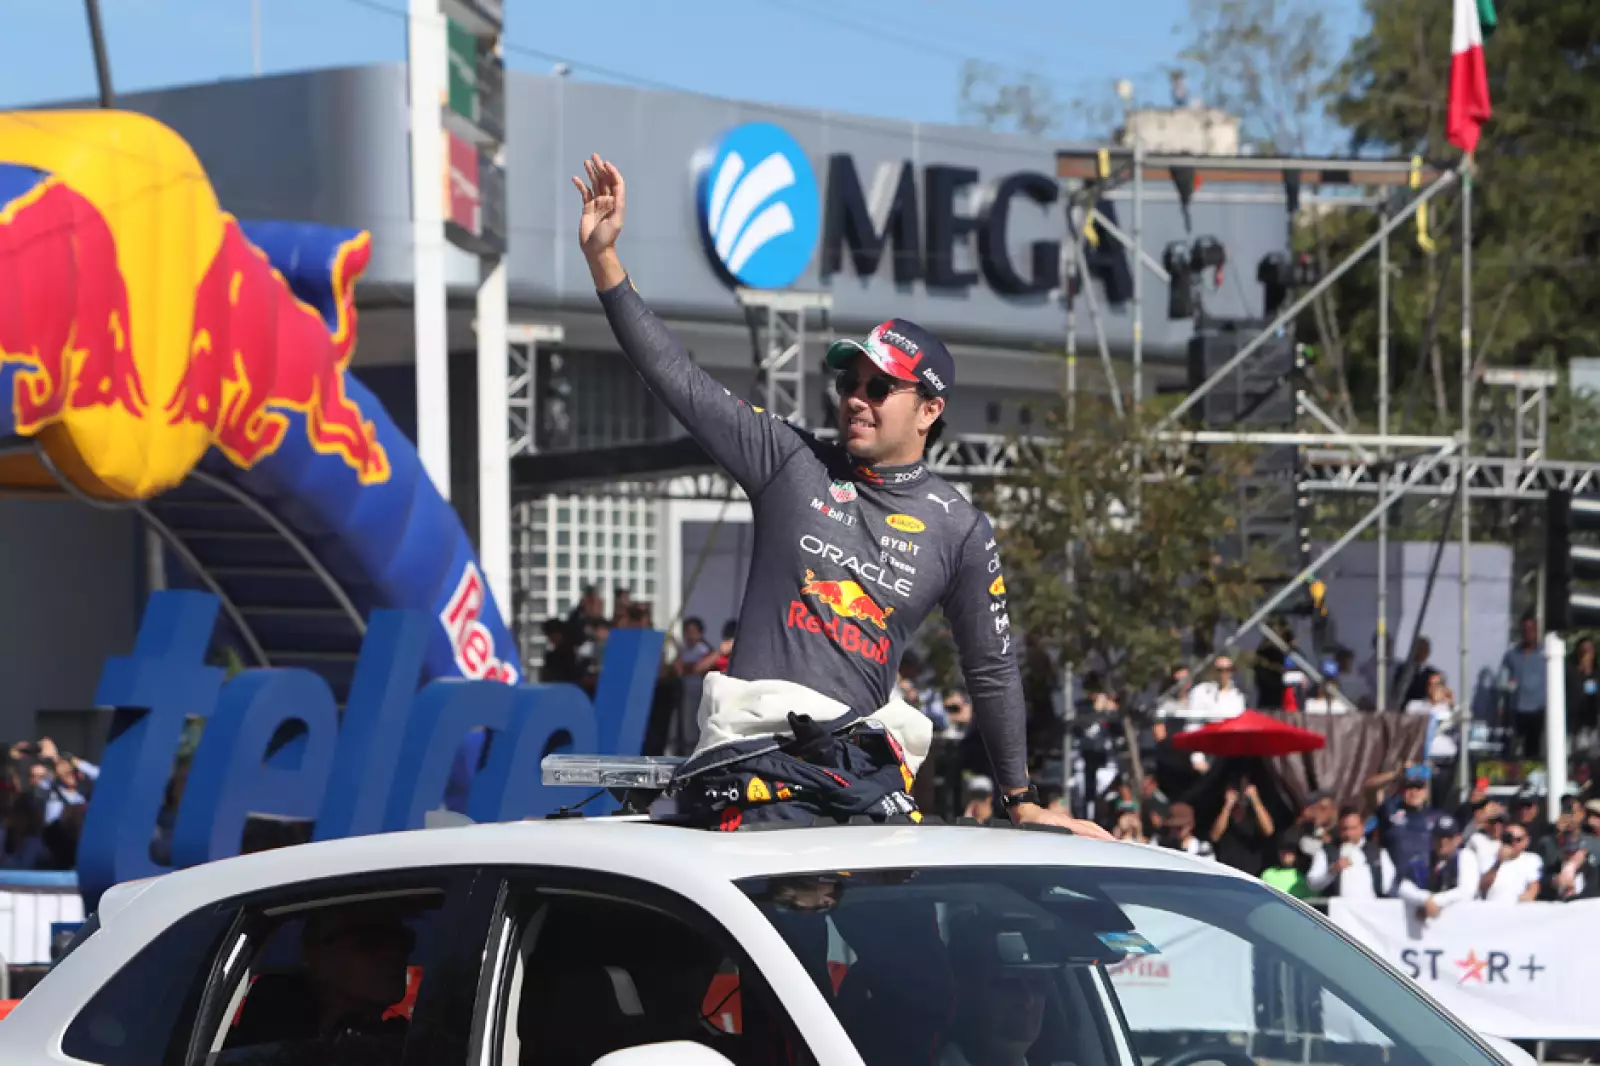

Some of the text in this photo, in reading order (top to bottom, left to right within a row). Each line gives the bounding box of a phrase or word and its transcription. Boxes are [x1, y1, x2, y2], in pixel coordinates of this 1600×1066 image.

[819, 152, 1136, 313] MEGA
[809, 497, 845, 523] Mobil
[800, 534, 913, 597] ORACLE
[880, 535, 920, 556] BYBIT
[76, 588, 664, 905] telcel
